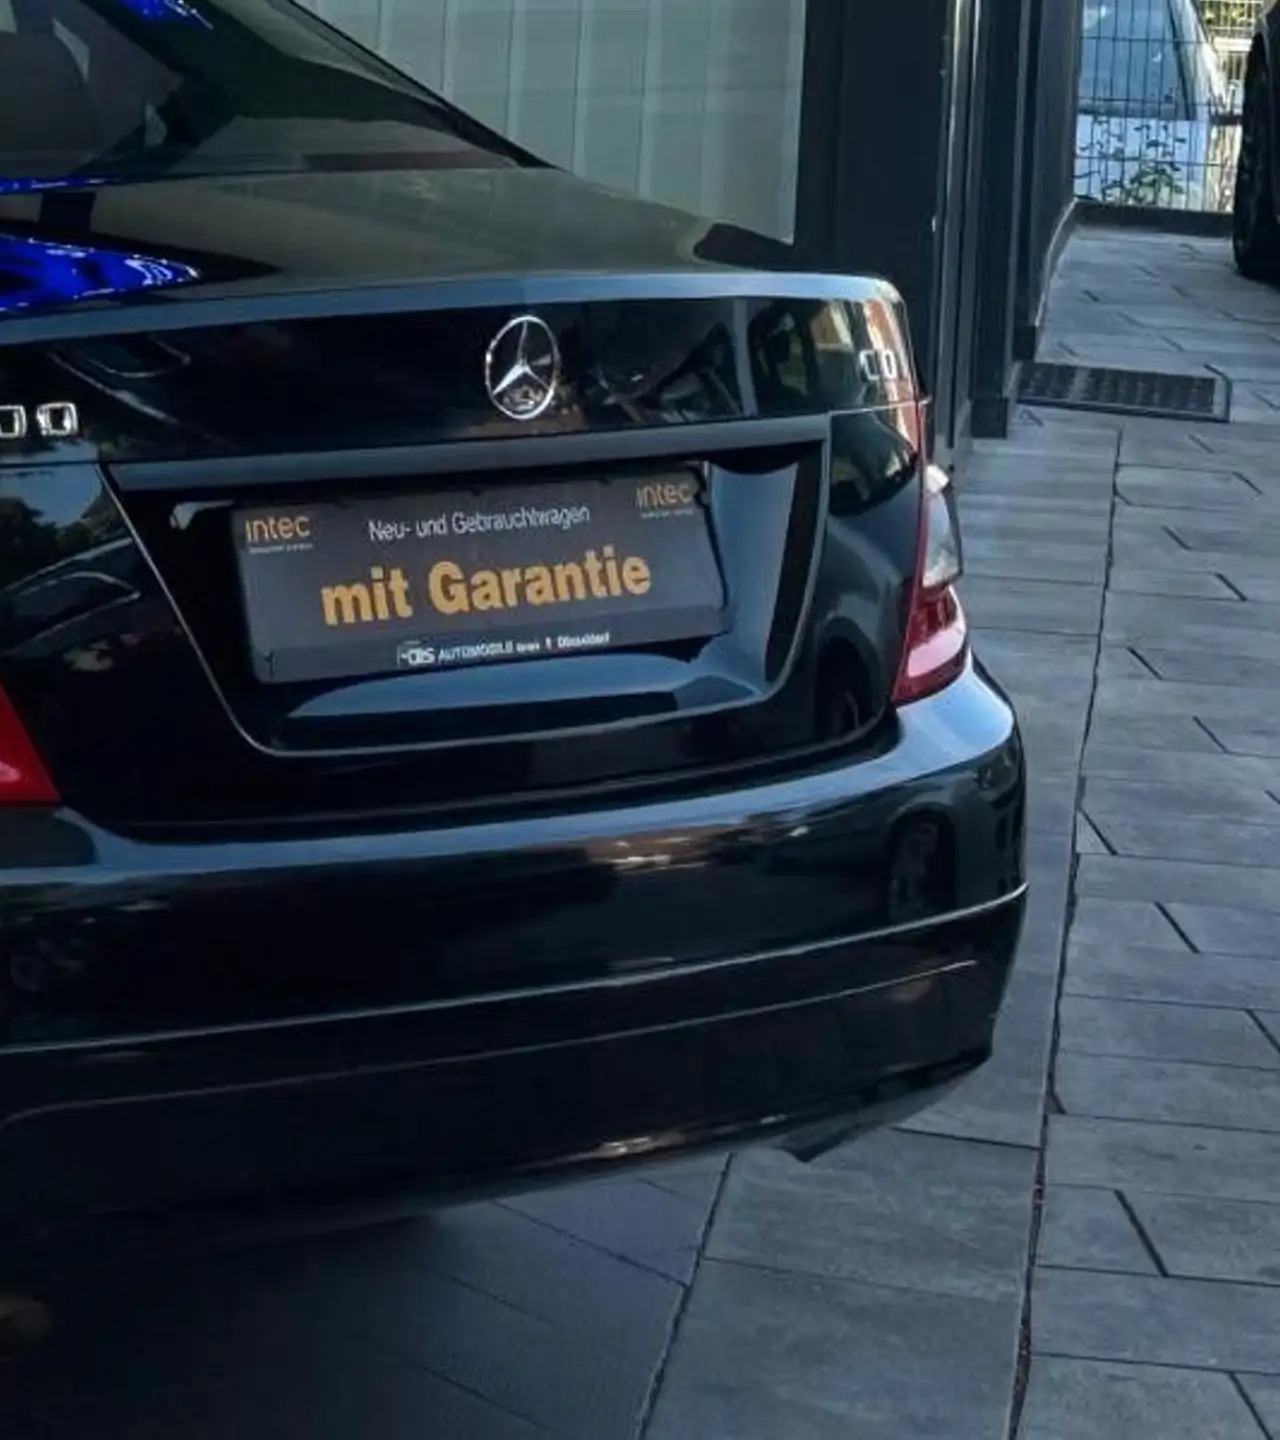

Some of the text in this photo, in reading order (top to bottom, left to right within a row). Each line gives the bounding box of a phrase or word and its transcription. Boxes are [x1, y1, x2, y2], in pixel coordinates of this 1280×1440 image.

[368, 505, 591, 541] Neu- und Gebrauchtwagen
[320, 544, 652, 626] mit Garantie
